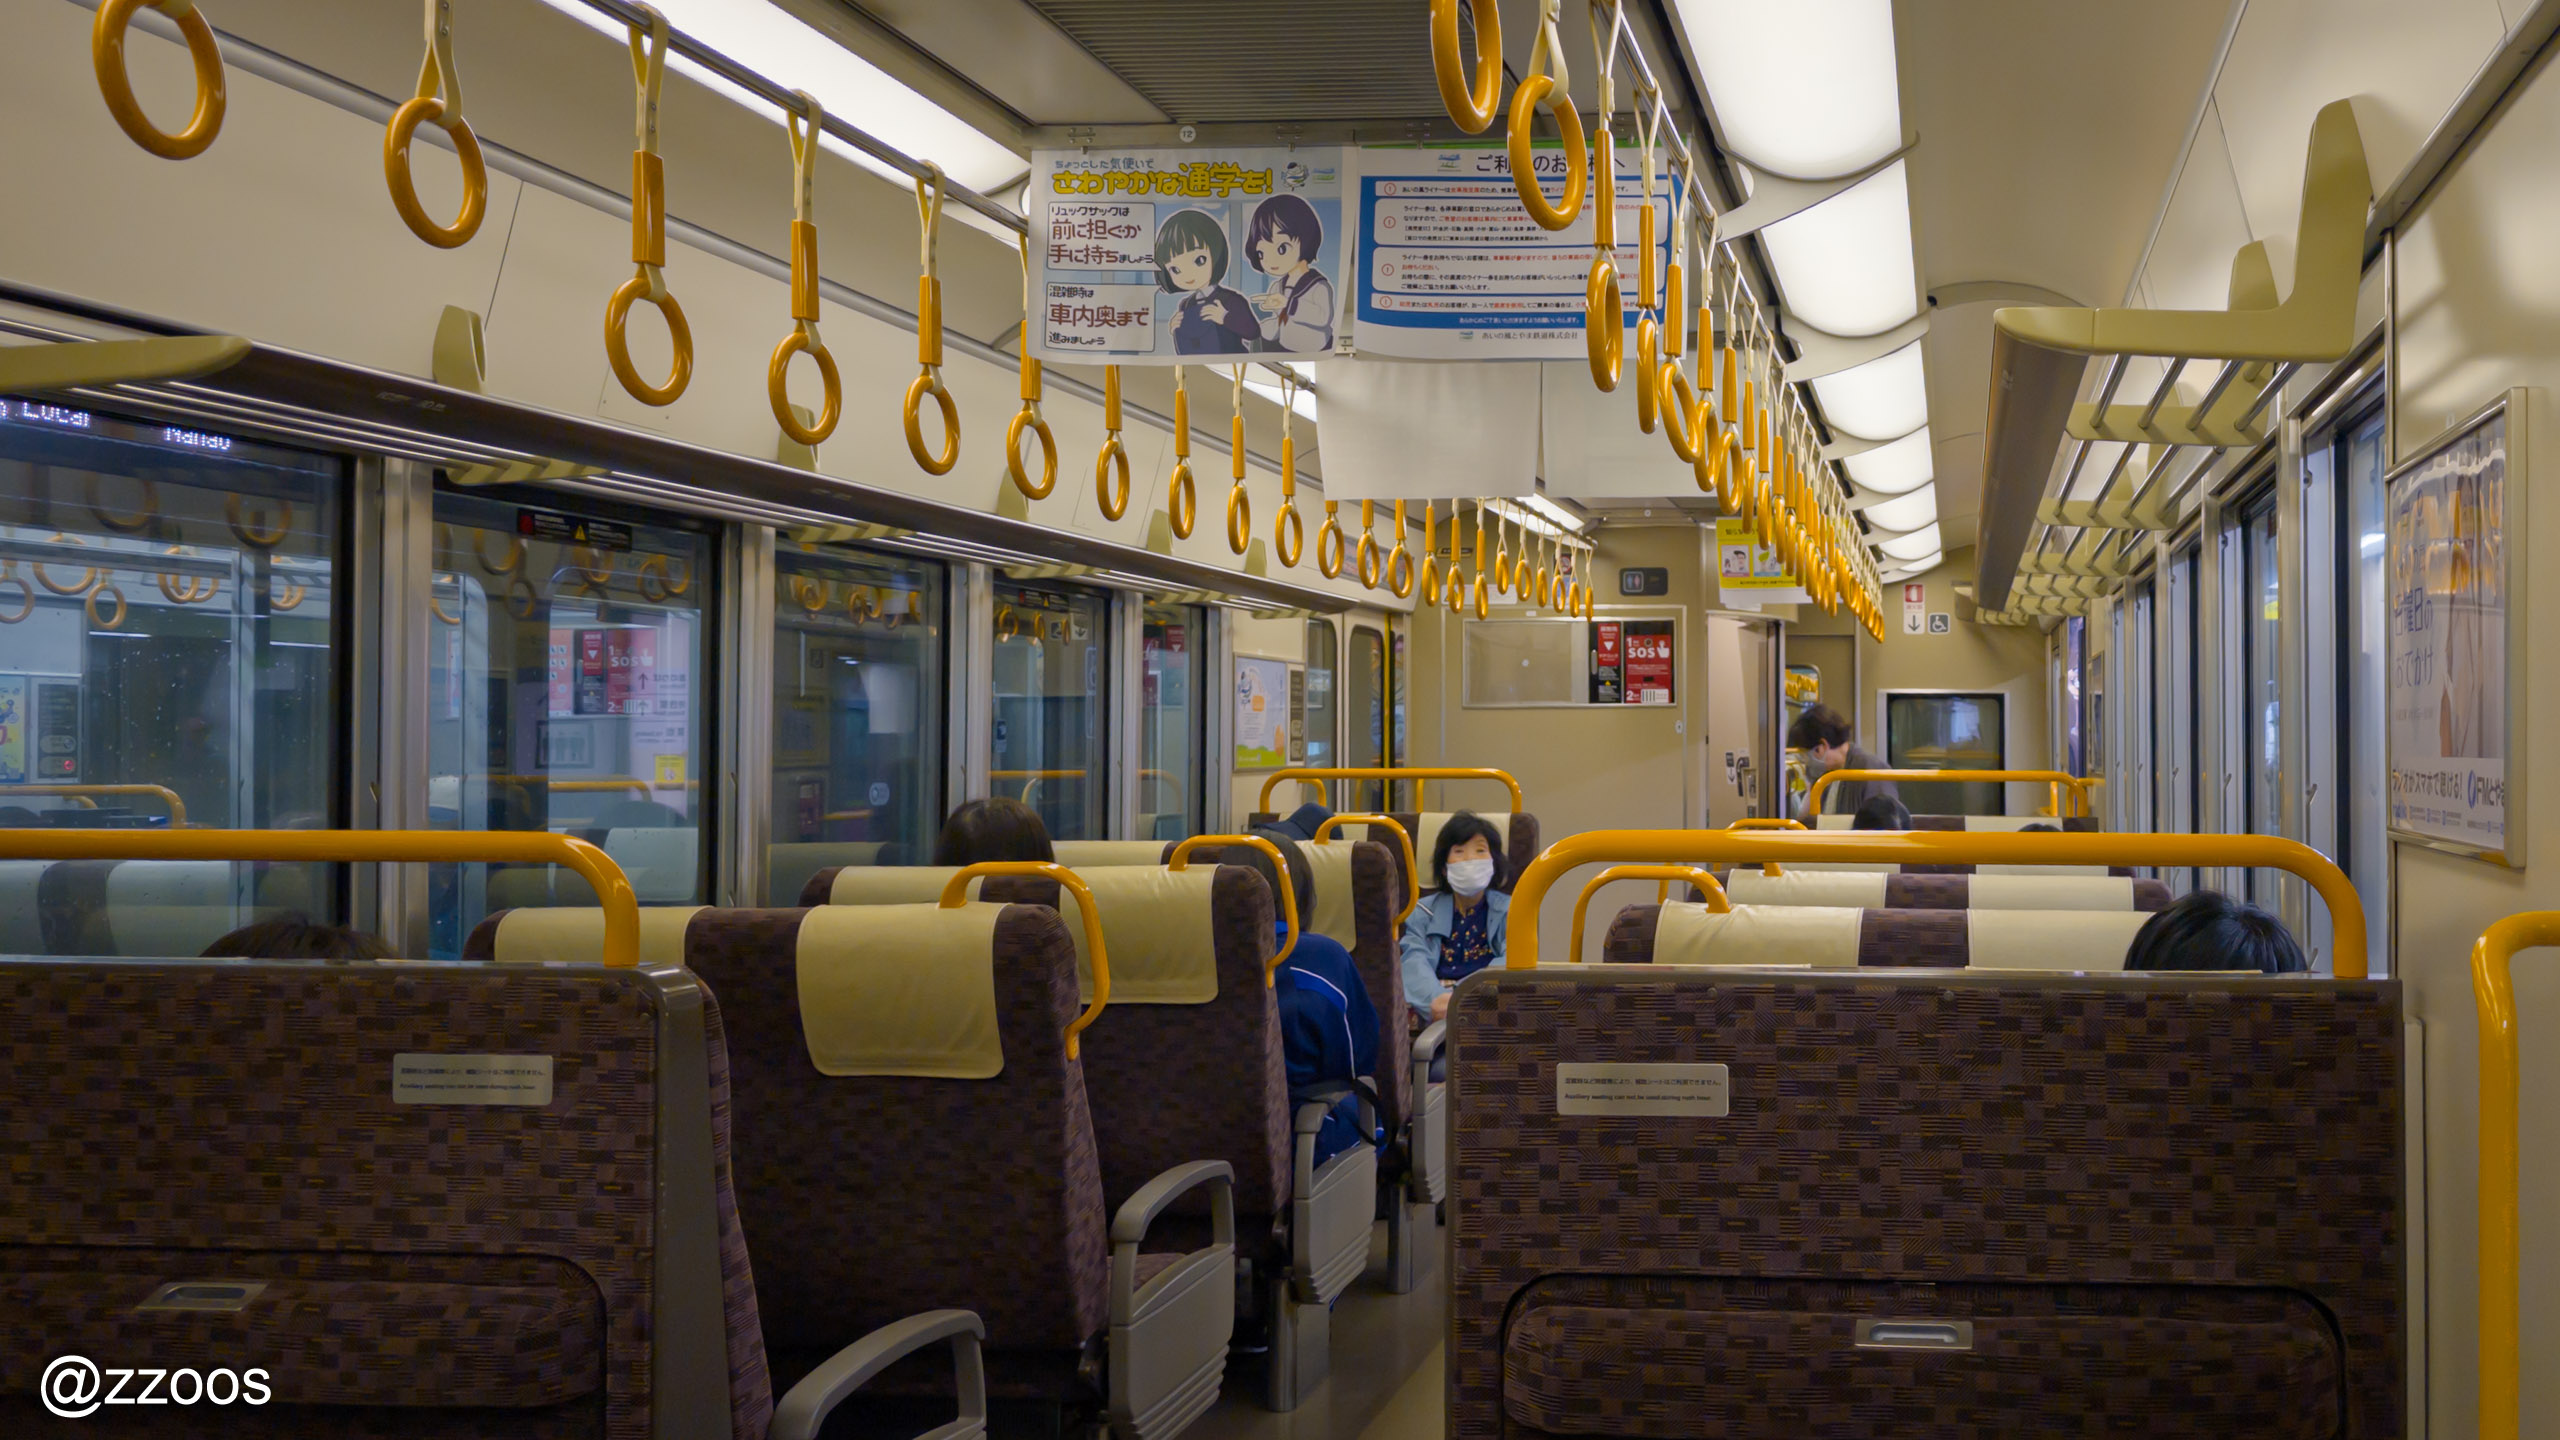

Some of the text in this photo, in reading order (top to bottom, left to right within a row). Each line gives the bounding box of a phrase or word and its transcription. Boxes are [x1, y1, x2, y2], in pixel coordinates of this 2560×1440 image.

[1051, 205, 1130, 217] リュックサックは
[1051, 219, 1142, 240] 前に担ぐか
[1048, 244, 1154, 265] 手に持ちましょう
[1048, 286, 1094, 298] 混雑時は
[1048, 304, 1150, 328] 車内奥まで
[1048, 332, 1106, 346] 進みましょう
[1628, 647, 1655, 658] SOS
[611, 656, 639, 668] SOS
